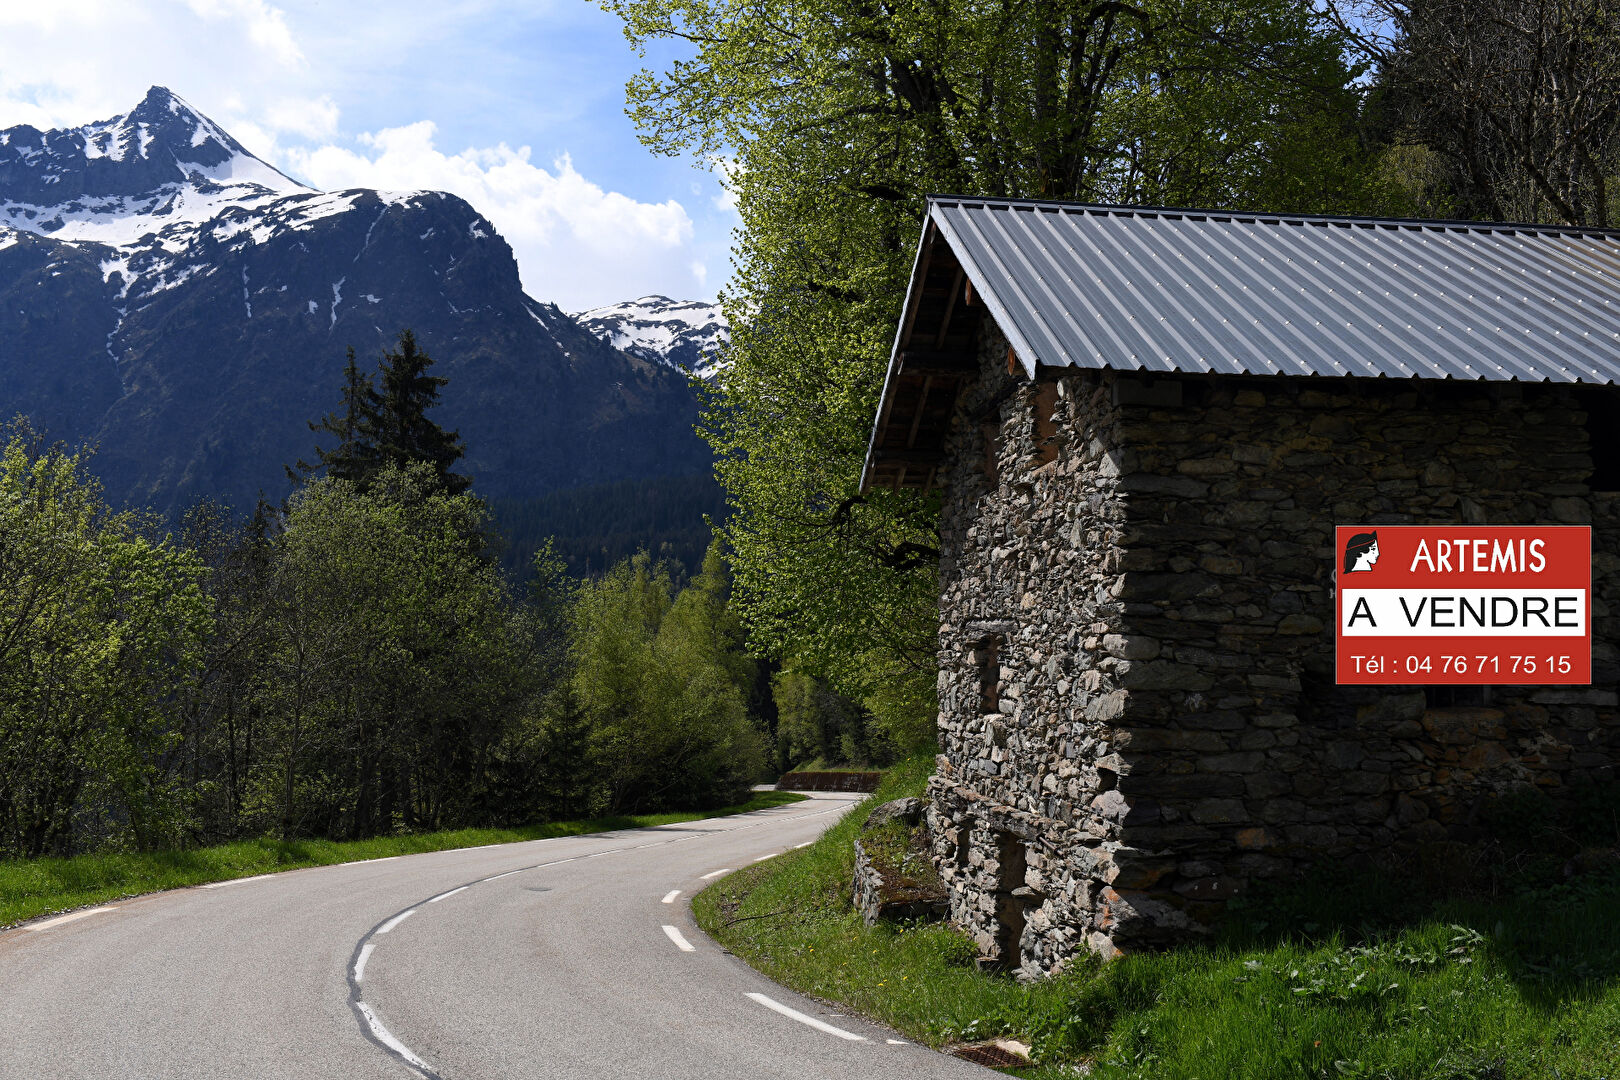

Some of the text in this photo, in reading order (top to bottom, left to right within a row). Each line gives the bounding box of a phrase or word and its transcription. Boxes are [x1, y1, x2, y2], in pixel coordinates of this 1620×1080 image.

[1409, 538, 1546, 573] ARTEMIS
[1347, 596, 1579, 628] A VENDRE
[1350, 655, 1384, 674] Tél
[1405, 655, 1433, 674] 04
[1440, 655, 1468, 674] 76
[1475, 655, 1500, 674] 71
[1509, 655, 1537, 674] 75
[1545, 655, 1572, 674] 15
